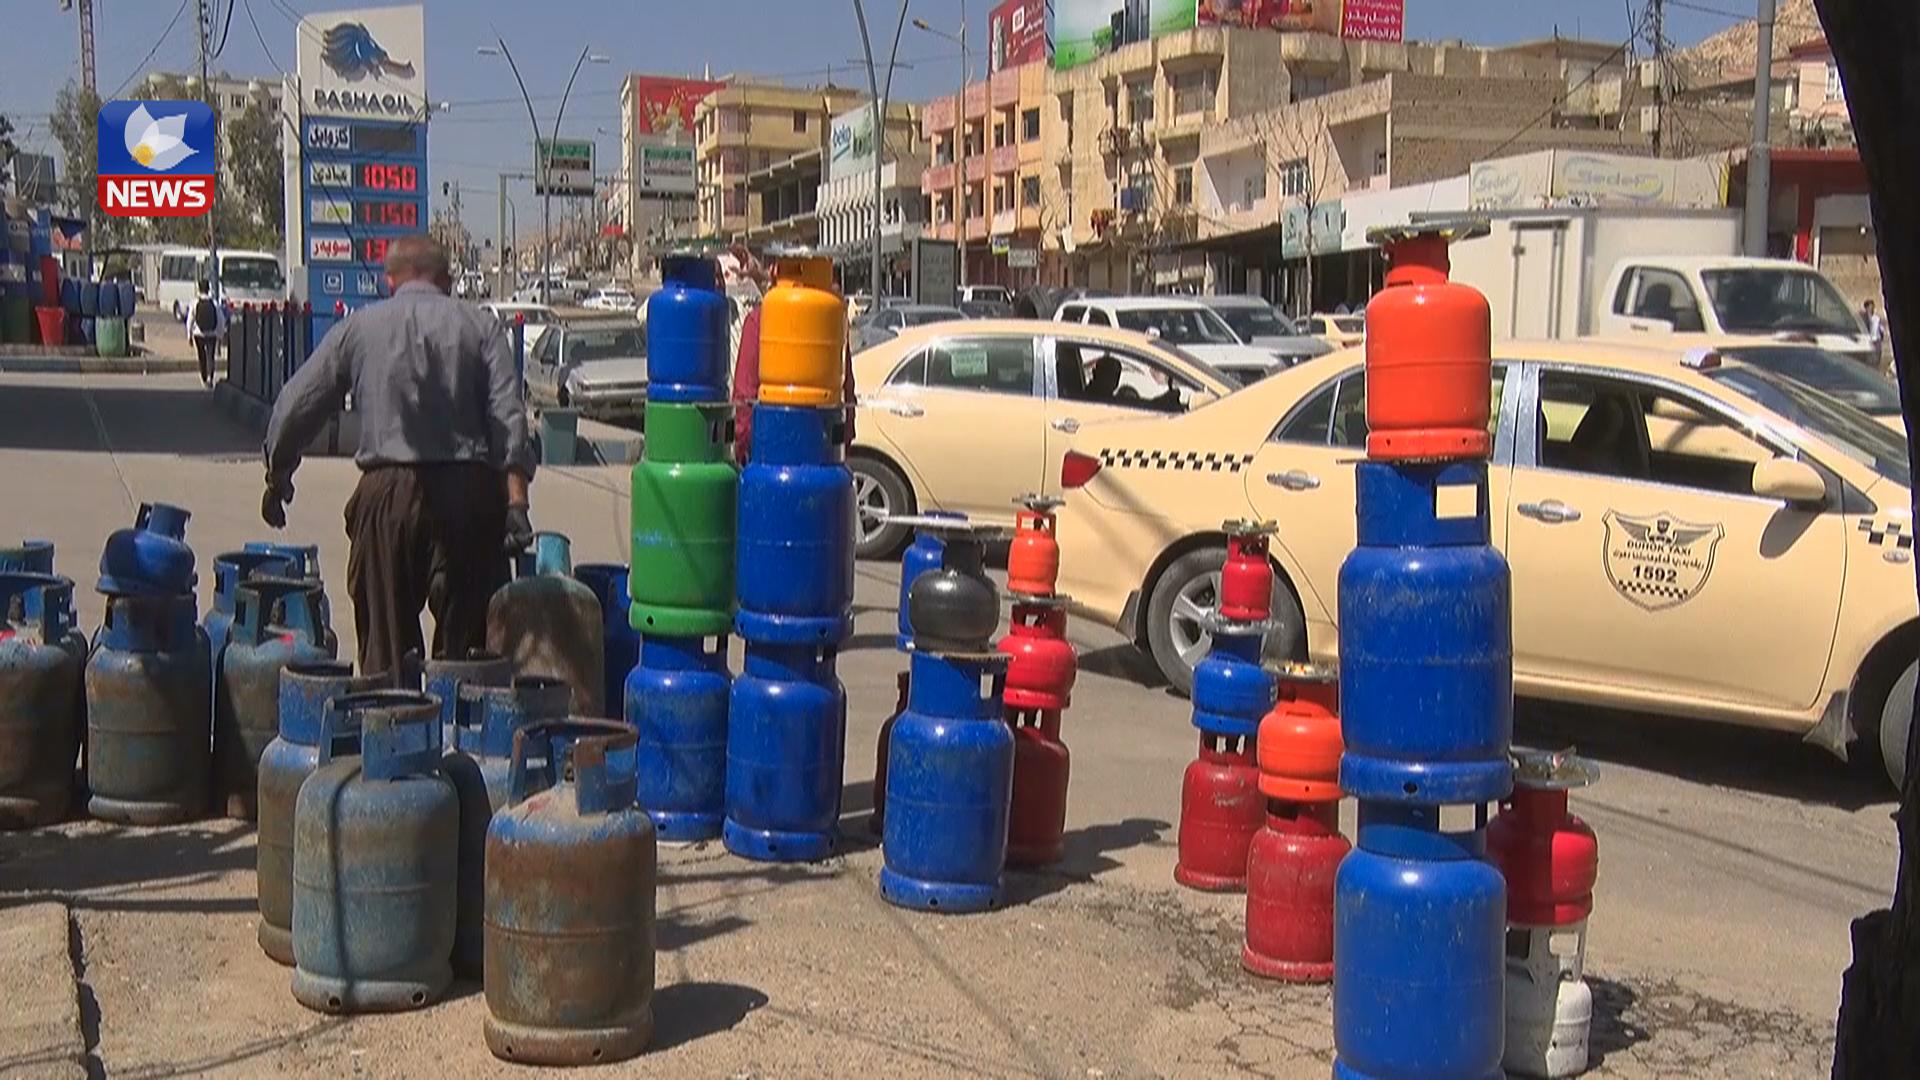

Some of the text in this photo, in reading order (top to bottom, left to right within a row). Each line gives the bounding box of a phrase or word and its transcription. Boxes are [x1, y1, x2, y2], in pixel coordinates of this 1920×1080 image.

[364, 163, 417, 192] 1050
[364, 201, 418, 227] 1150
[1626, 539, 1691, 557] DUHOK TAXI
[1632, 564, 1677, 585] 1592
